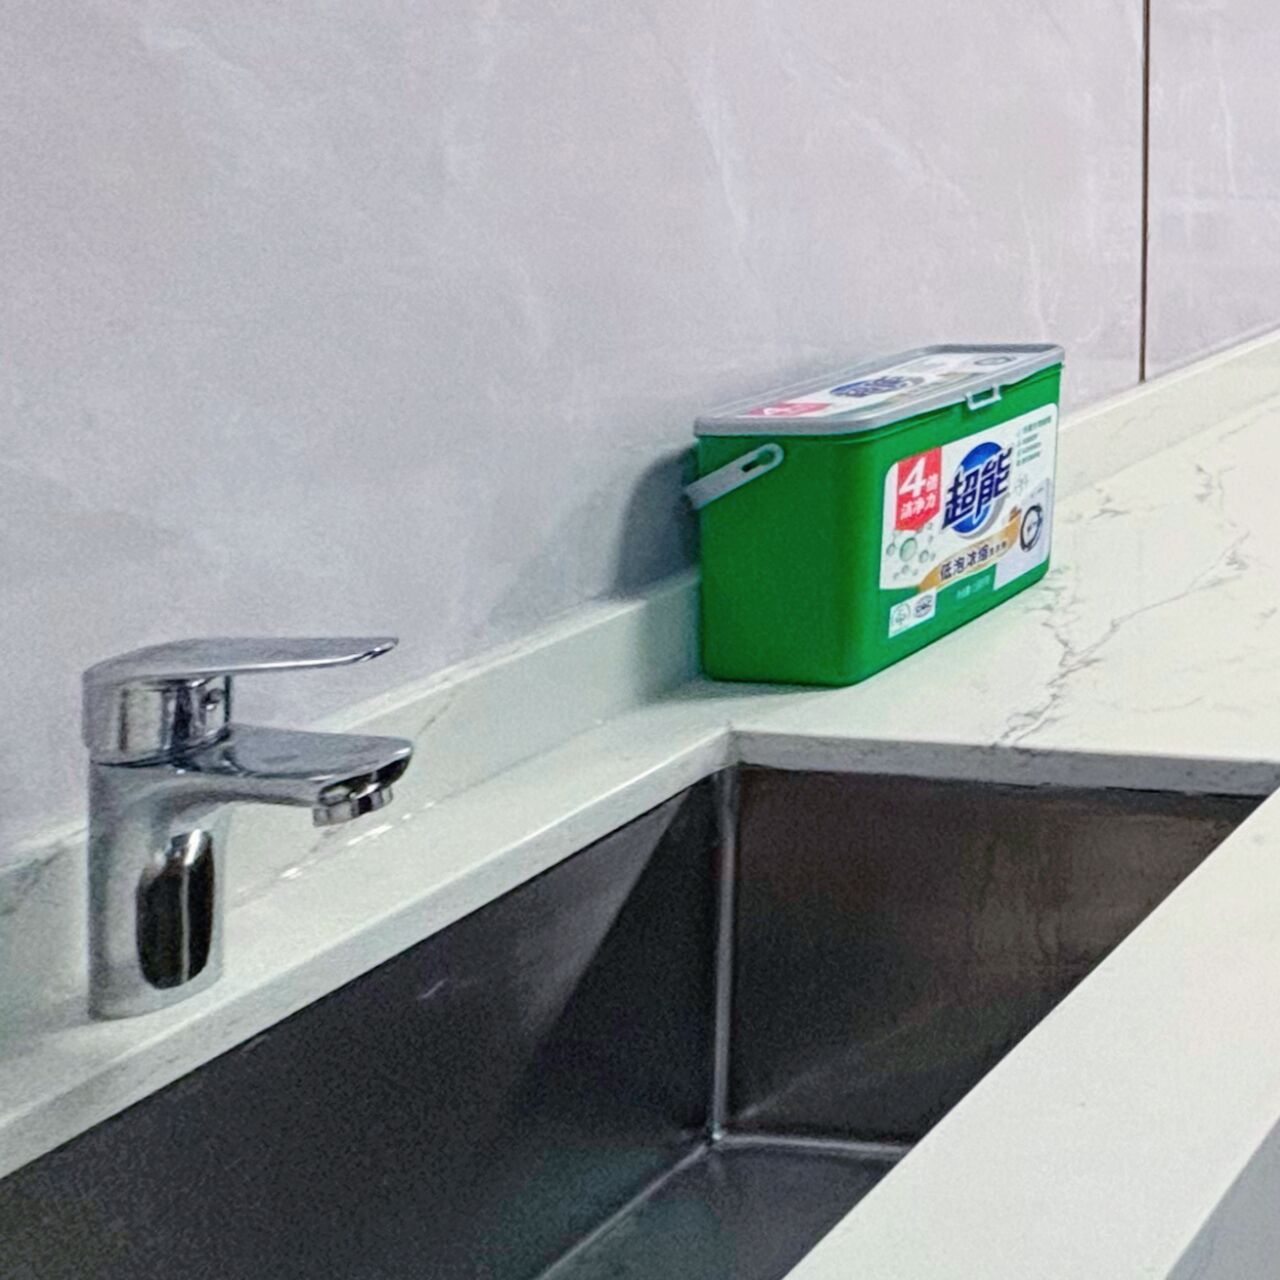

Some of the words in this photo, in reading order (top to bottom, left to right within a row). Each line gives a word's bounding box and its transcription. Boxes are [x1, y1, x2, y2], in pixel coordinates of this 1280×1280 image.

[900, 493, 937, 521] 洁净力
[942, 446, 1013, 530] 超能
